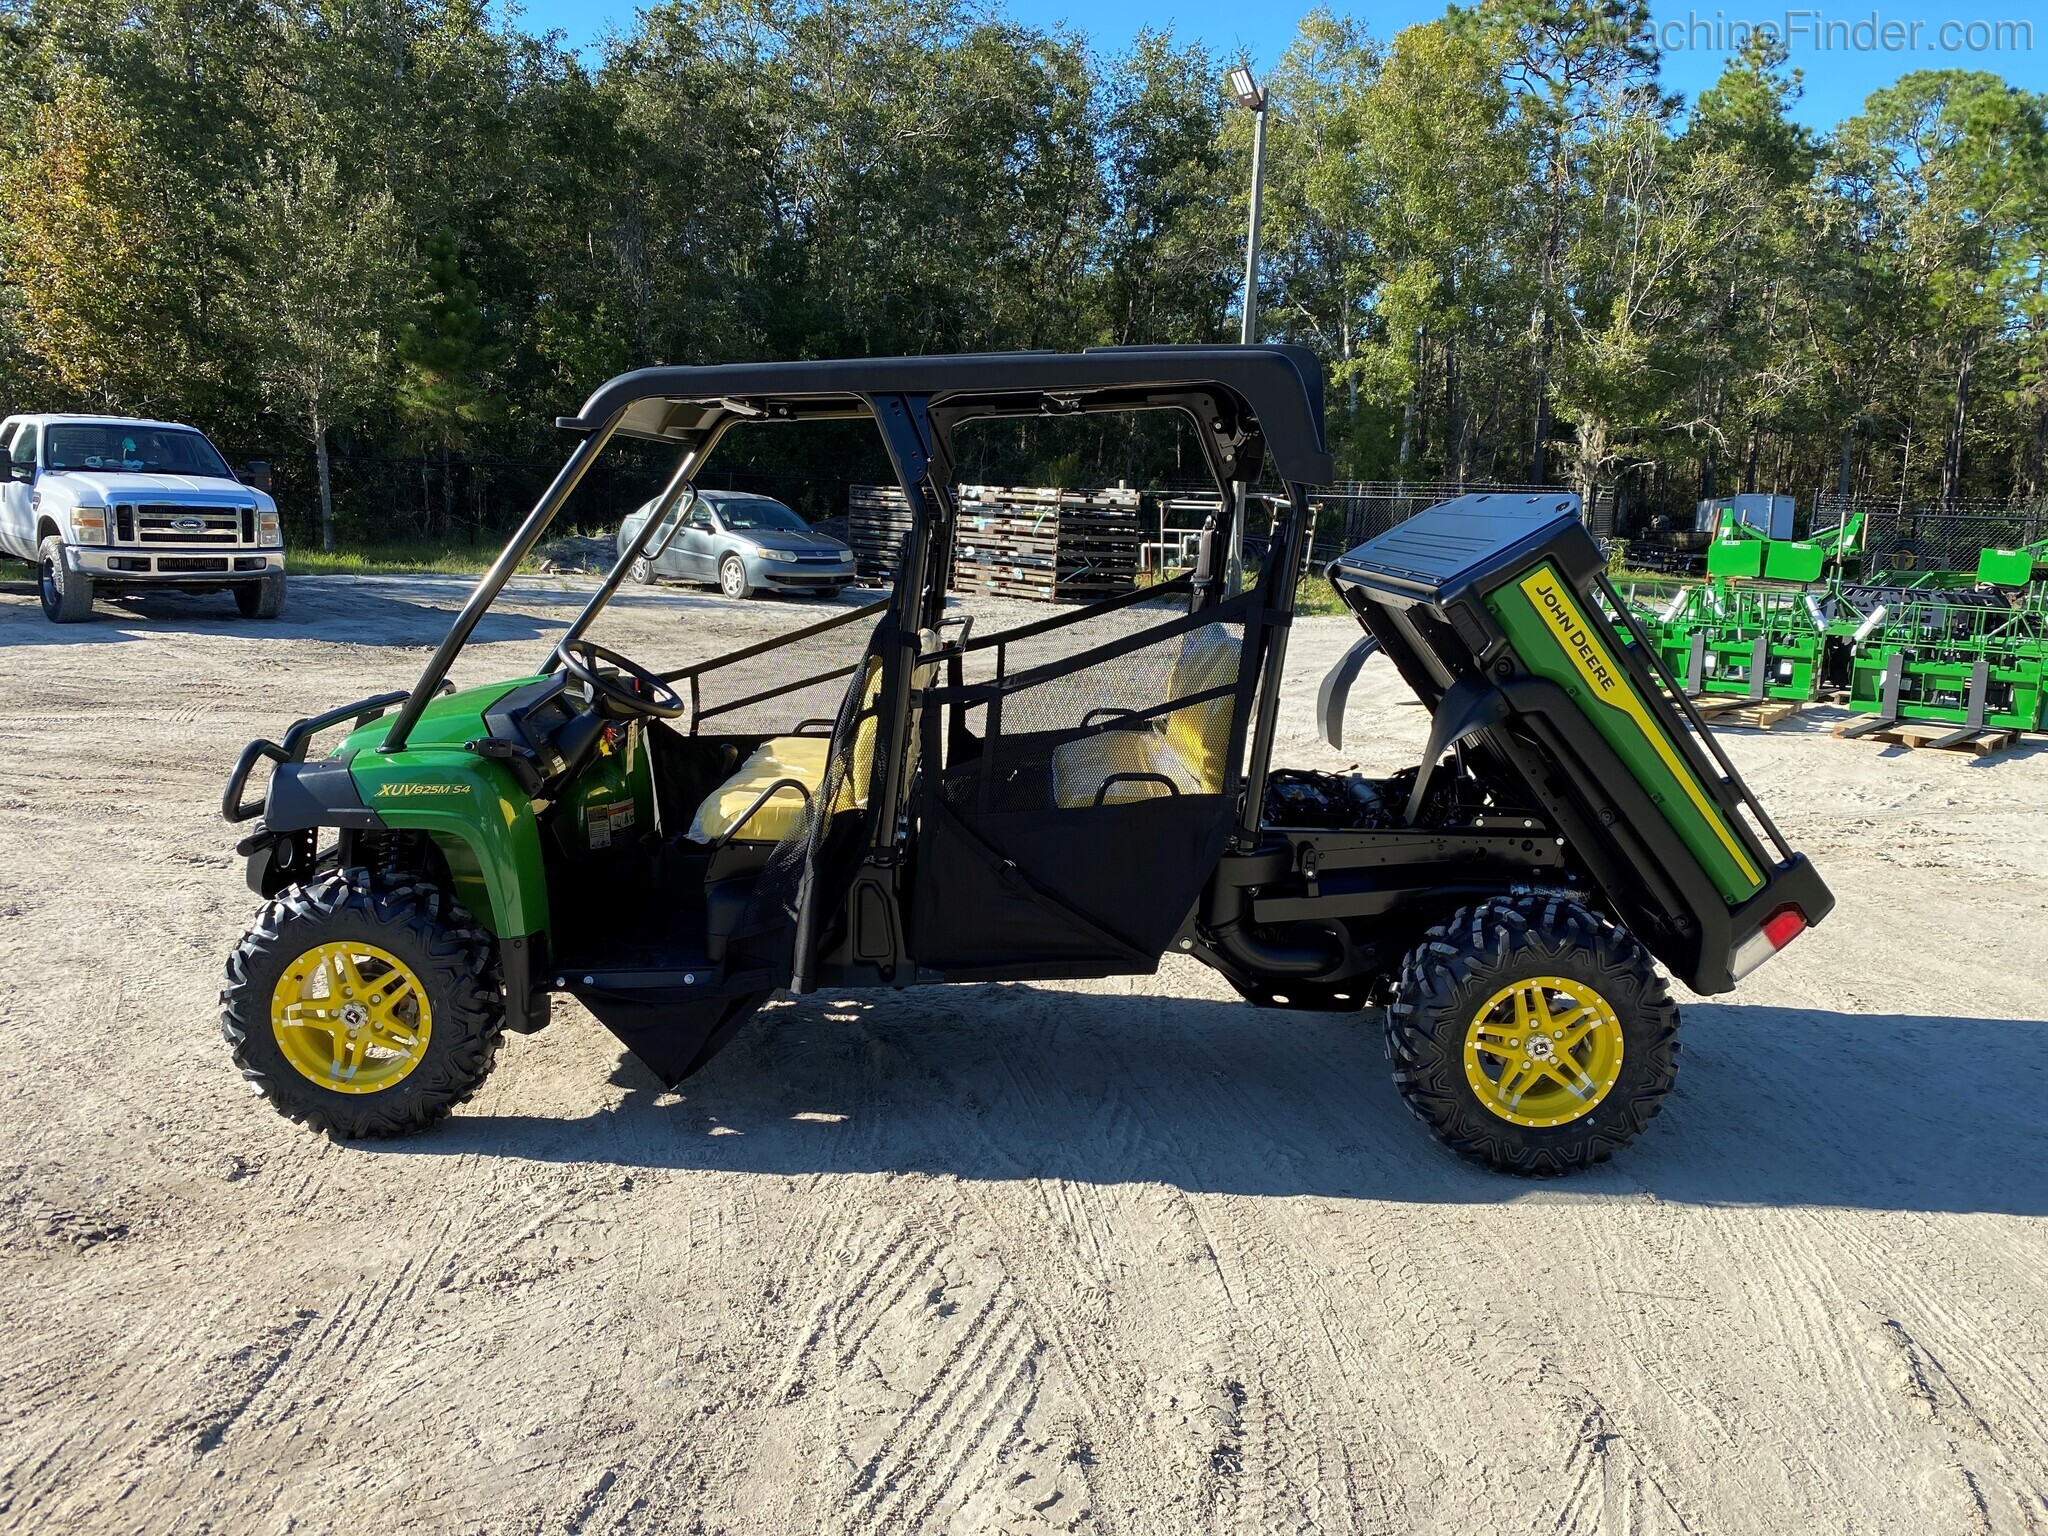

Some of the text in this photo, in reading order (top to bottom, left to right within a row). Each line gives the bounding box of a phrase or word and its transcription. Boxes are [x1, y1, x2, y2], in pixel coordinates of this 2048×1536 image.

[1535, 586, 1615, 692] JOHN DEERE
[374, 784, 471, 797] XUV825M S4
